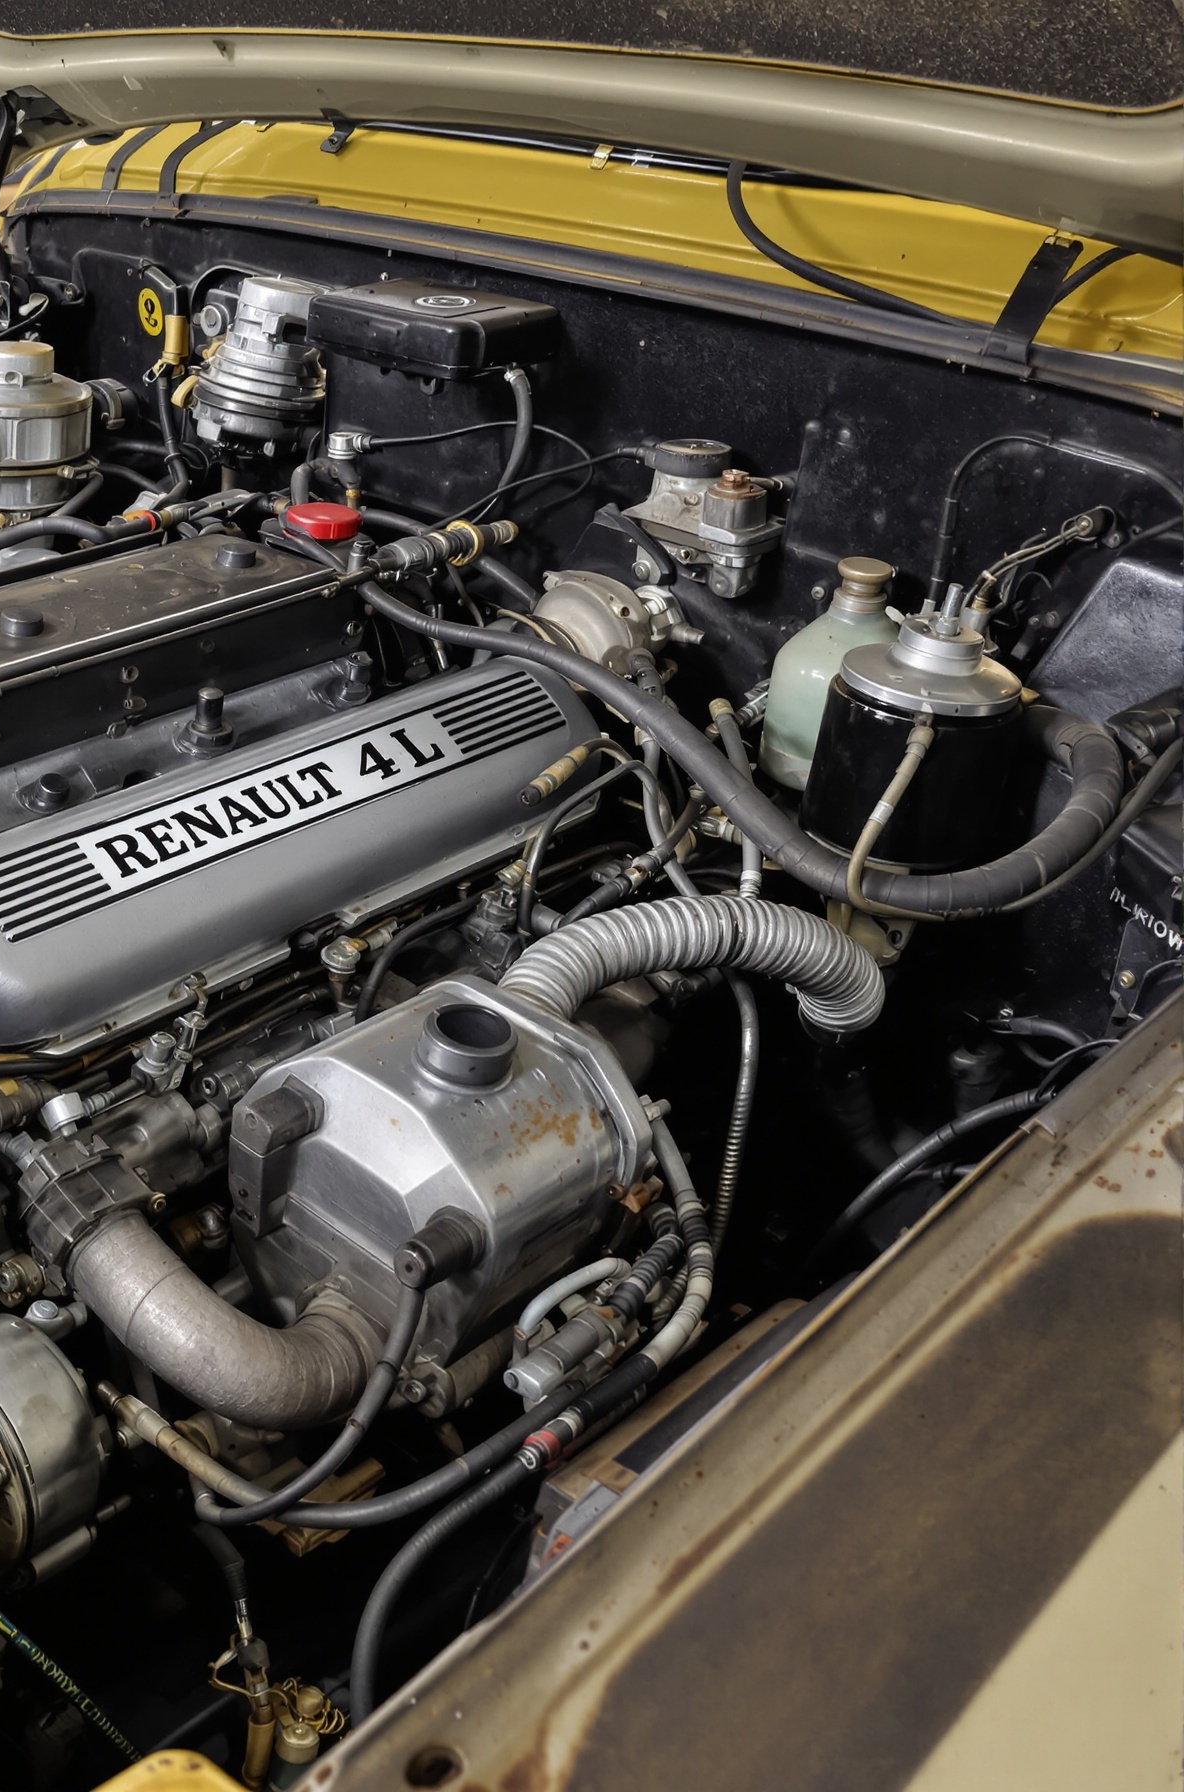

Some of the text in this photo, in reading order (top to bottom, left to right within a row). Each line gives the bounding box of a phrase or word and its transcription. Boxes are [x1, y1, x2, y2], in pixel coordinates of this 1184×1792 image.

[95, 728, 445, 878] RENAULT 4 L
